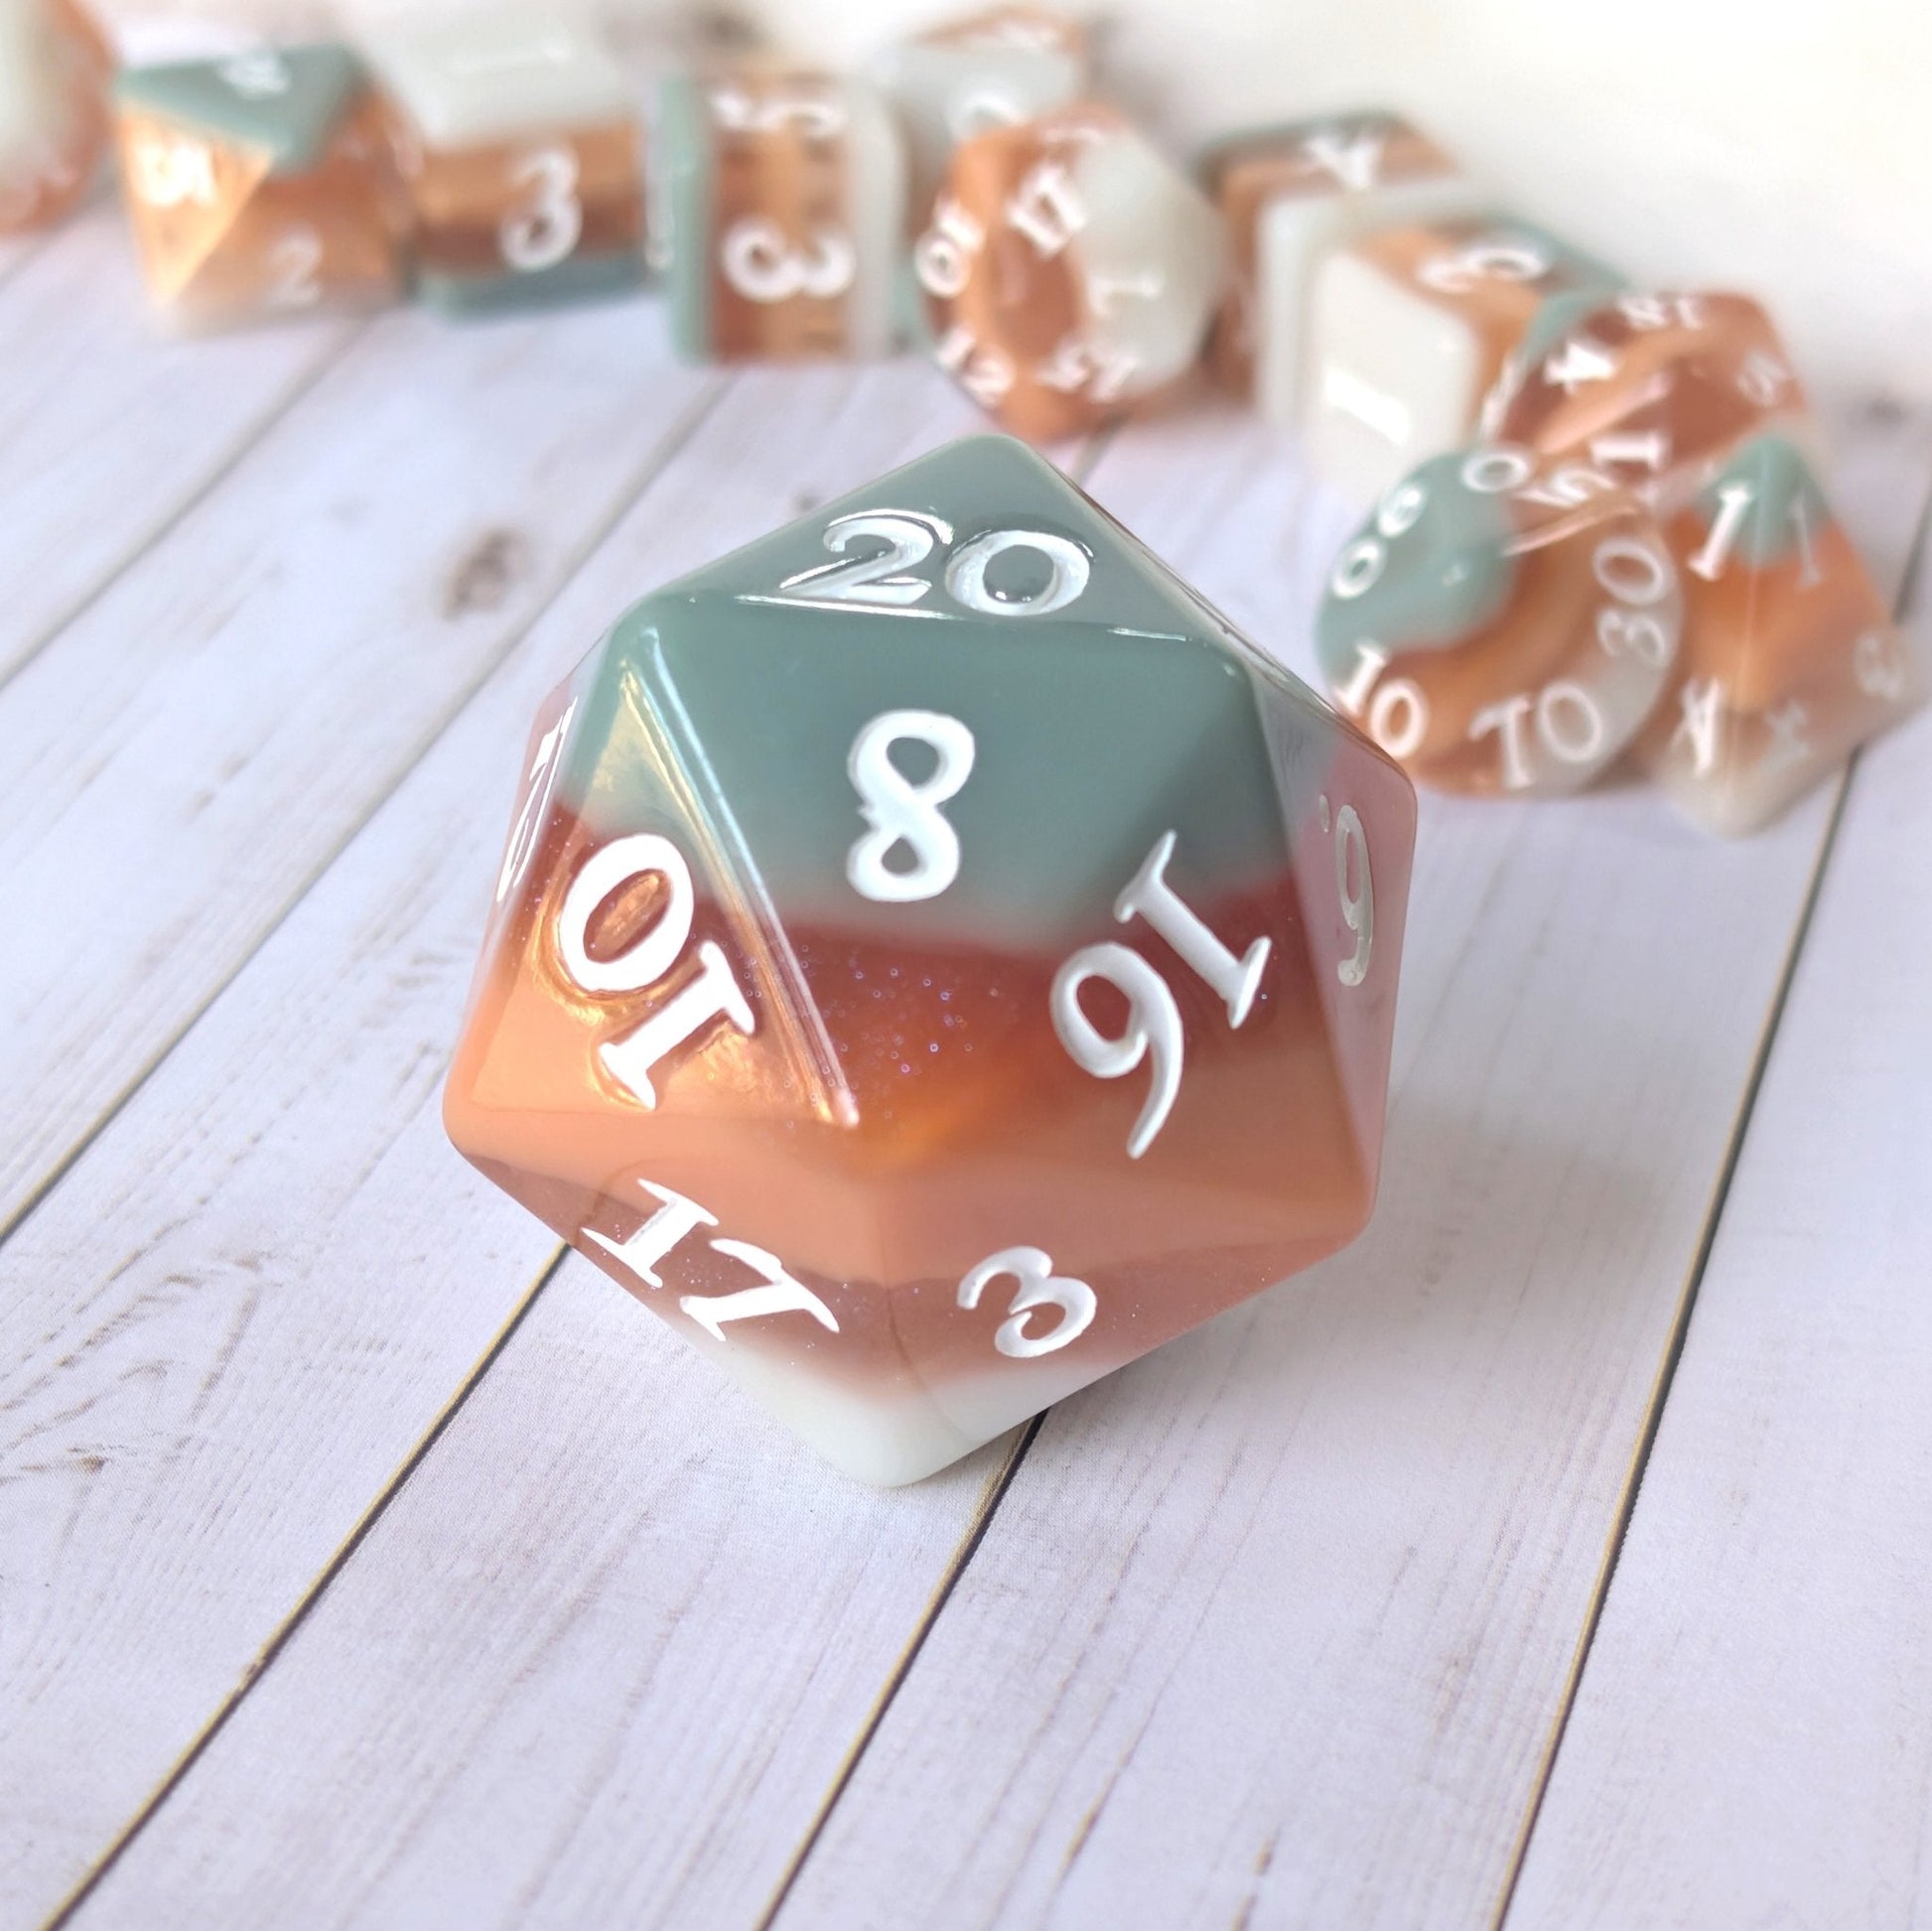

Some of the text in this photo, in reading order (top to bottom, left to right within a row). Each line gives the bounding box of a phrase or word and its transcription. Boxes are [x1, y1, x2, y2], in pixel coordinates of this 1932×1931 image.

[269, 224, 324, 307] 2
[501, 146, 583, 272] 3
[723, 215, 857, 302] 3
[779, 509, 1093, 618] 20
[1688, 482, 1750, 582] 1
[1593, 537, 1667, 666] 30
[1336, 640, 1429, 759] 10
[1469, 681, 1603, 789] 70
[848, 709, 976, 902] 8
[559, 833, 757, 1112] 10
[1049, 830, 1273, 1161] 16
[582, 1176, 840, 1343] 17
[957, 1246, 1097, 1358] 3
